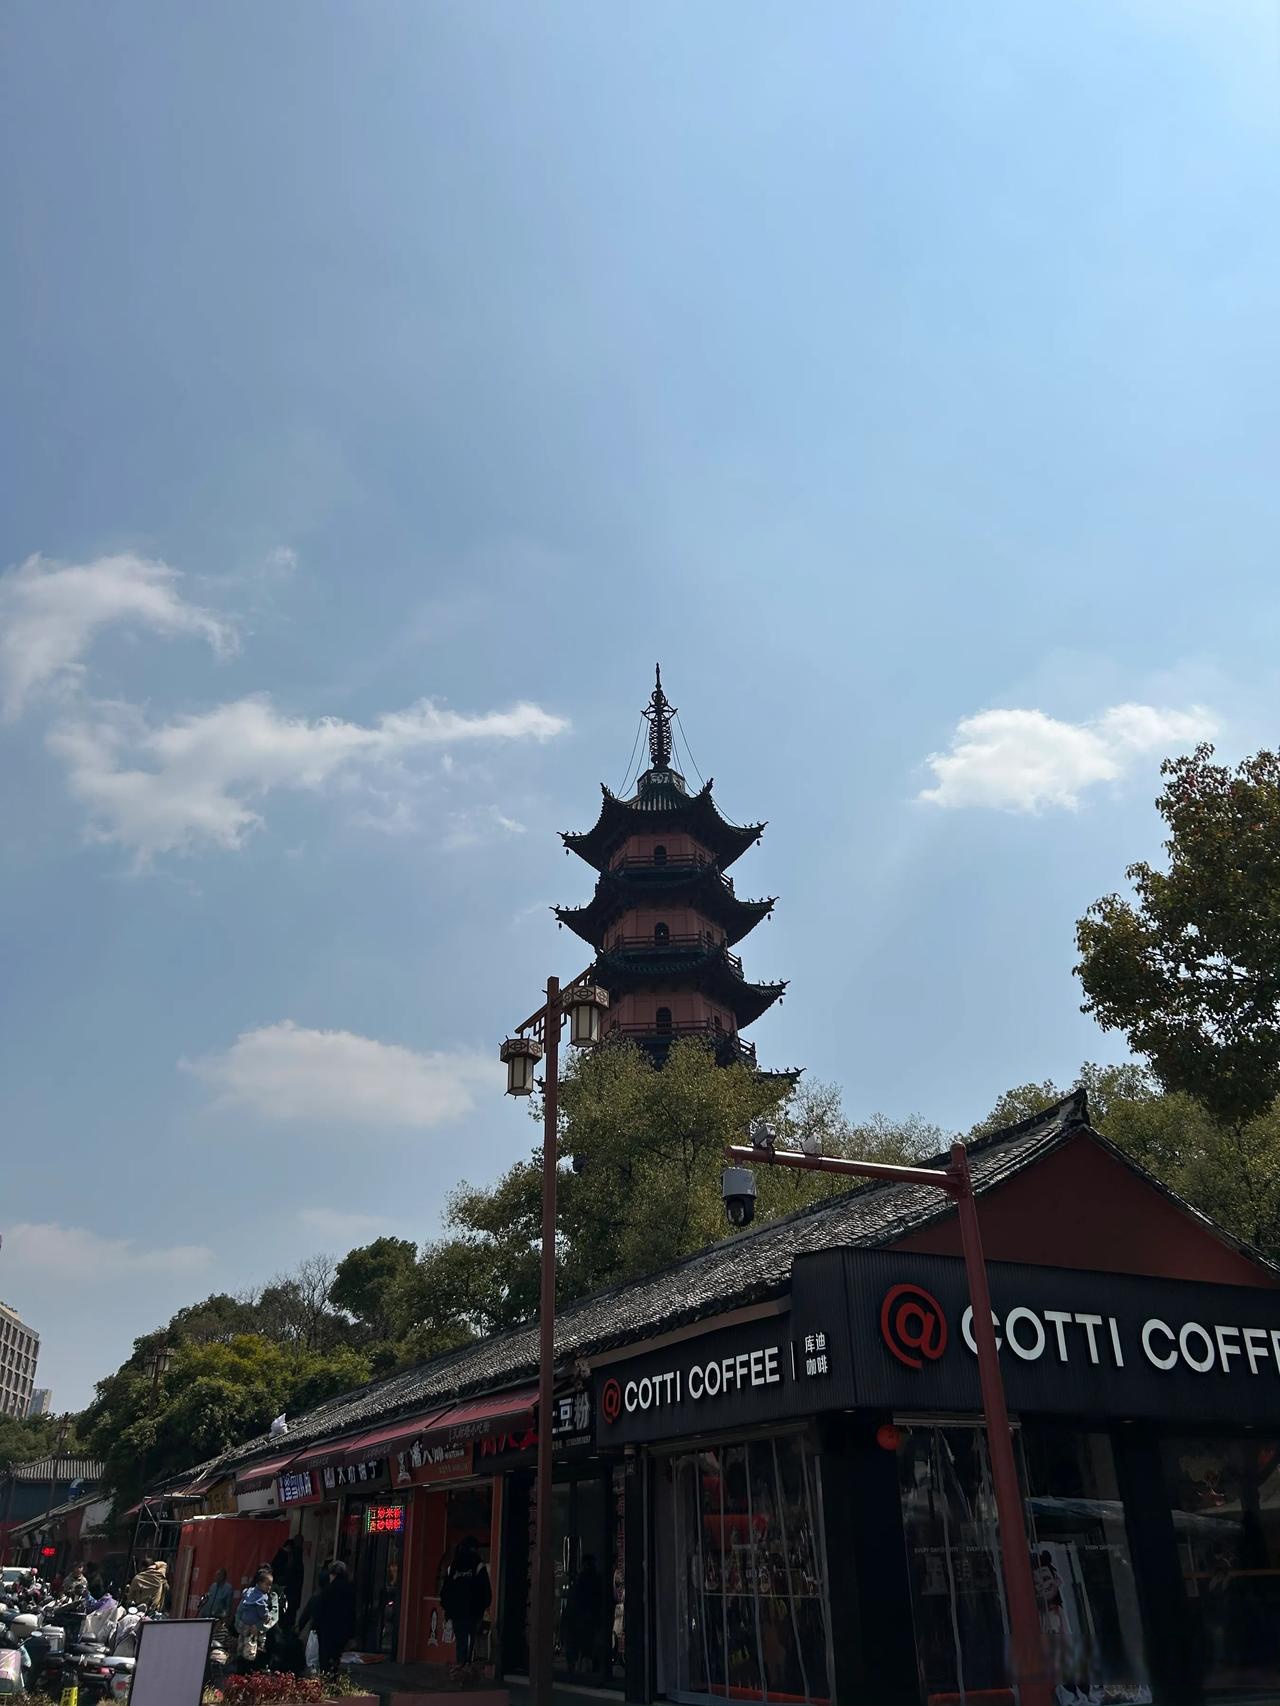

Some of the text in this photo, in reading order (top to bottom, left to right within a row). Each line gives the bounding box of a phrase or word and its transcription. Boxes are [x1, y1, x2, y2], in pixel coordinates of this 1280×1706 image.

[804, 1332, 827, 1354] 库迪
[806, 1355, 828, 1376] 咖啡
[624, 1370, 681, 1412] COTTI
[688, 1346, 780, 1399] COFFEE
